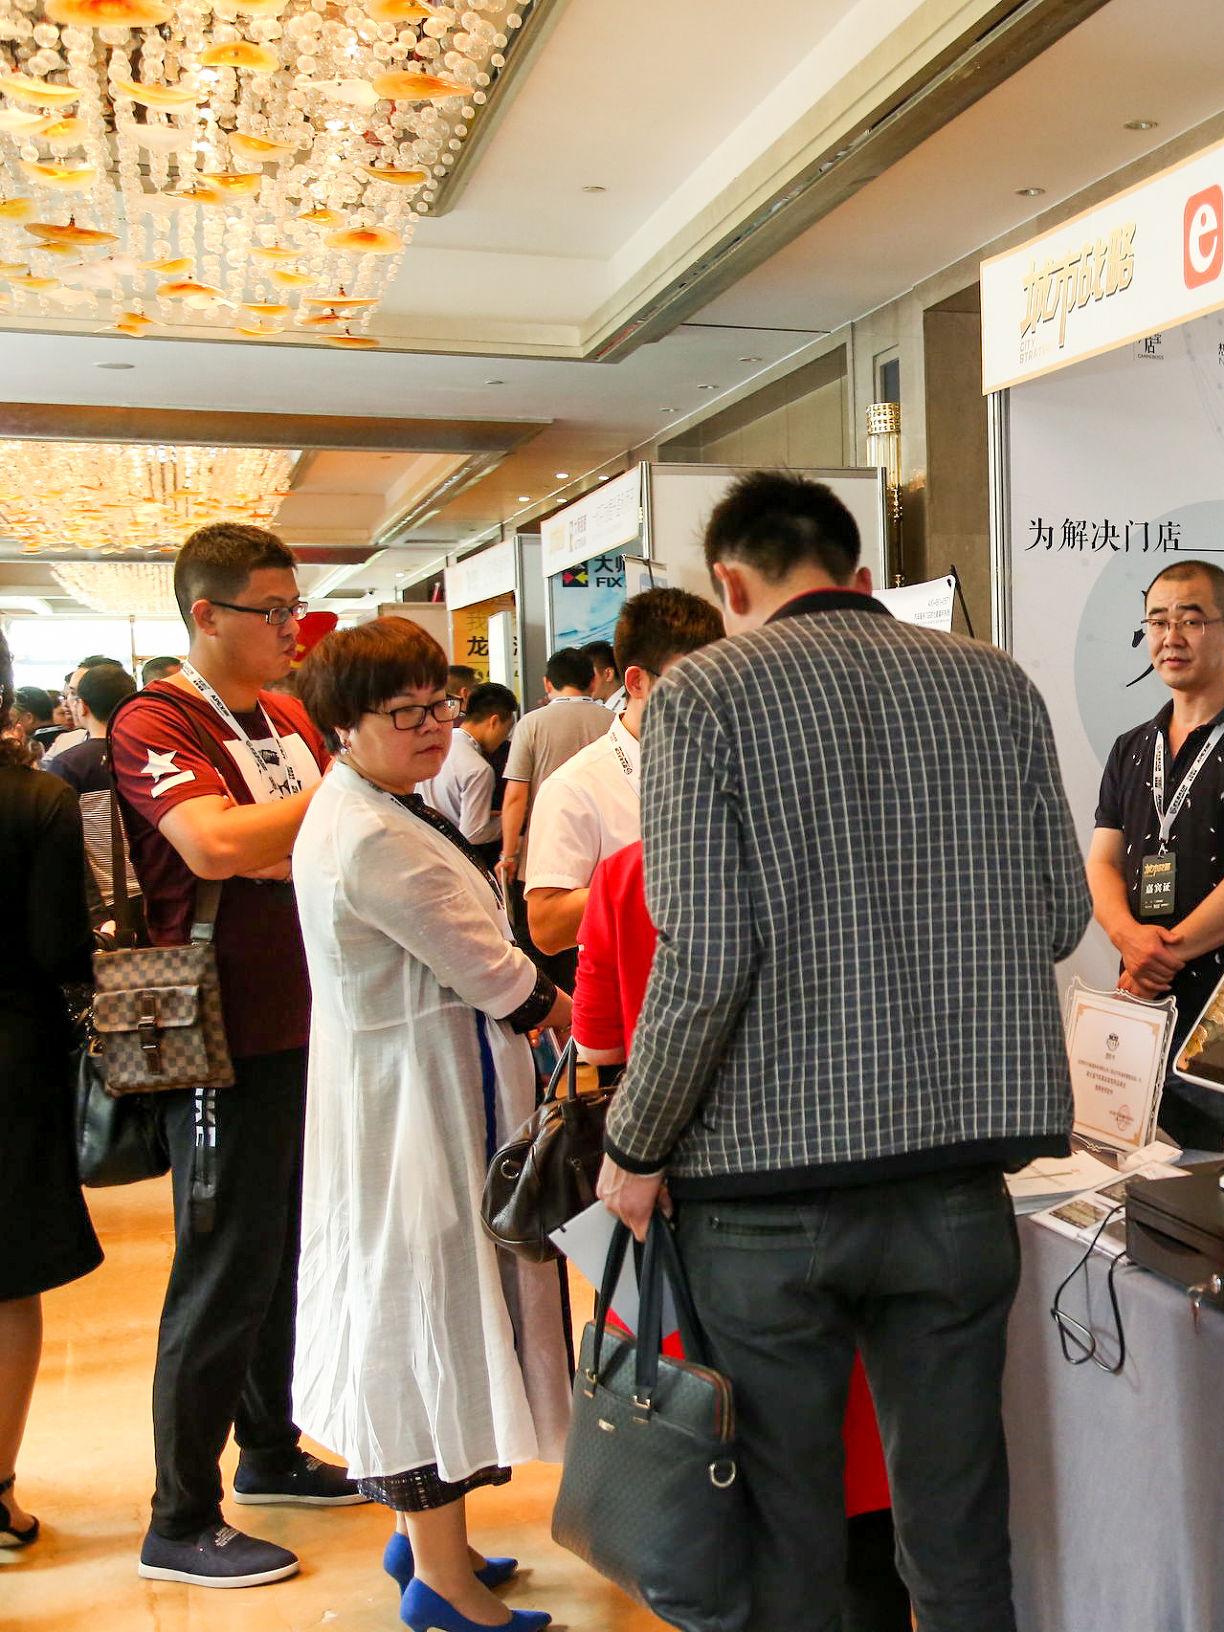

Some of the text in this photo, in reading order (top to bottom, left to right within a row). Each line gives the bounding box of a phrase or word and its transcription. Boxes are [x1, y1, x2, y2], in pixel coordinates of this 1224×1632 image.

[1025, 517, 1181, 552] 为解决门店
[596, 577, 623, 588] FIX
